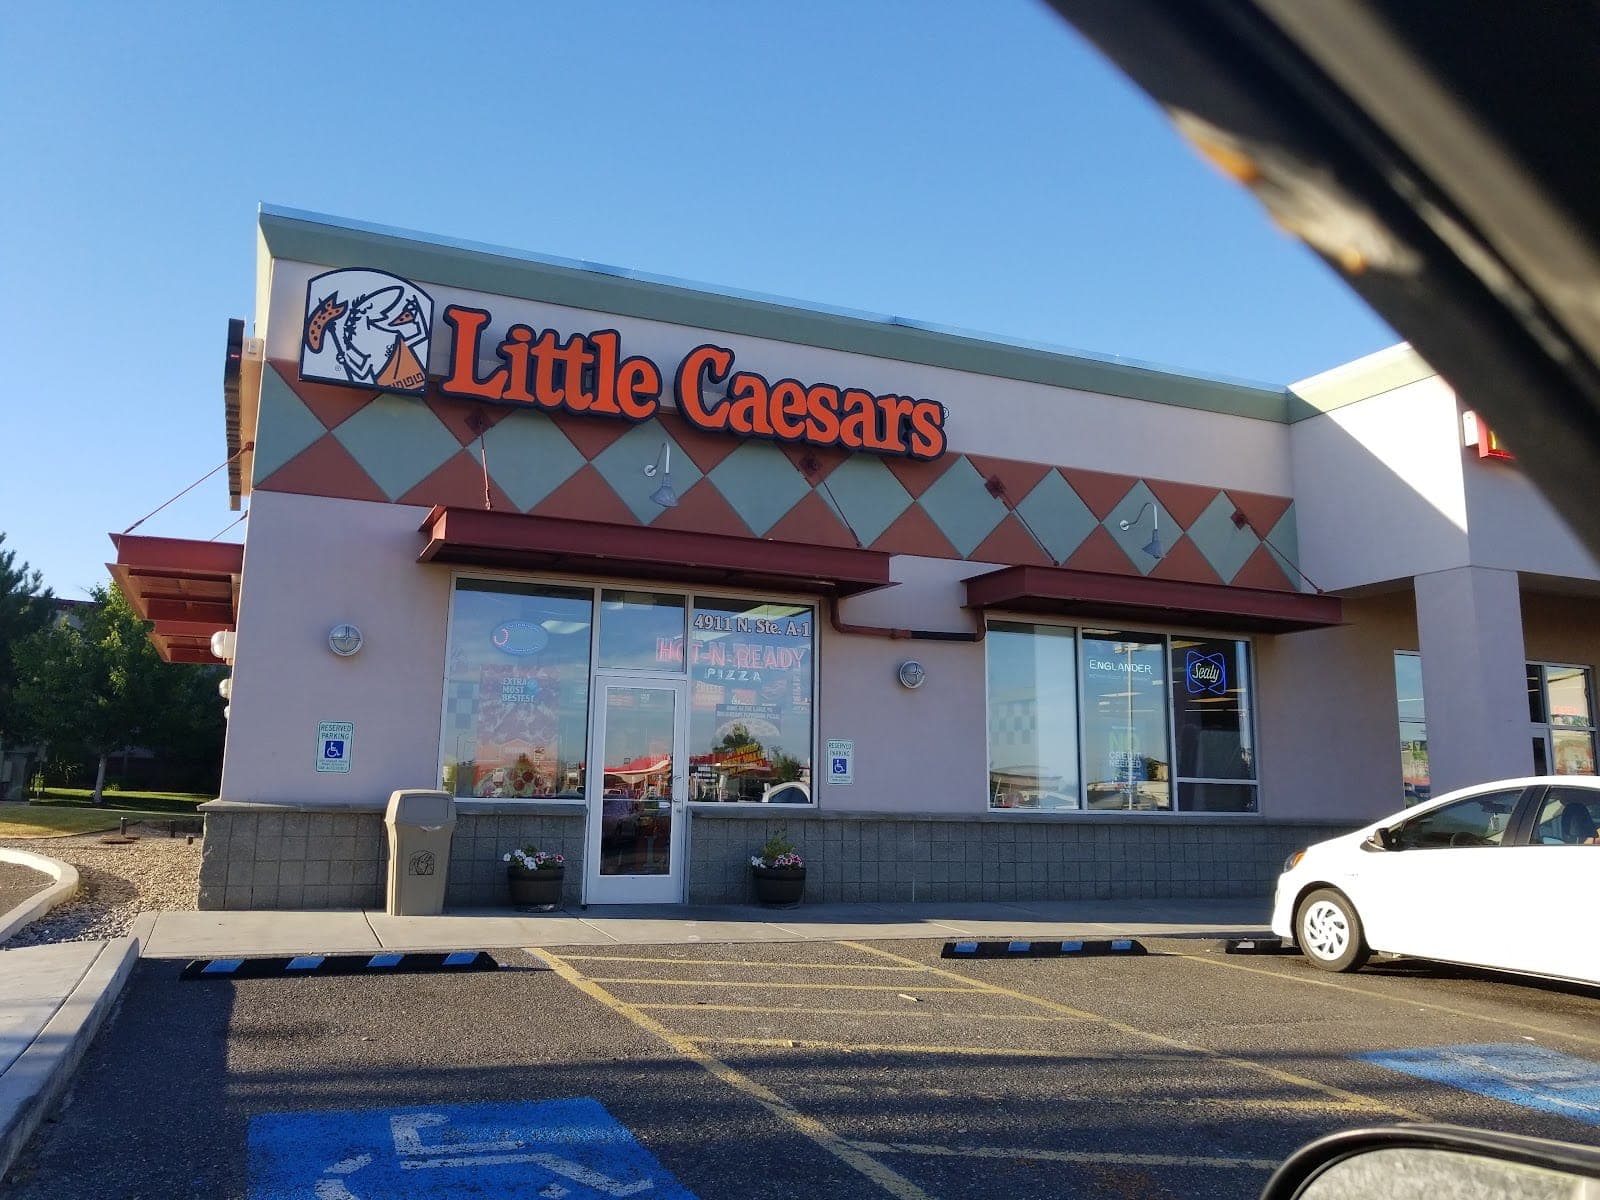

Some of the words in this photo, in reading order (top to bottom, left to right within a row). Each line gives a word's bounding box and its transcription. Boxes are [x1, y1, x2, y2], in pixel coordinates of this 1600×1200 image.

[443, 306, 661, 421] Little
[675, 345, 945, 460] Caesars
[694, 614, 732, 631] 4911
[736, 618, 752, 632] N.
[756, 619, 782, 634] Ste.
[786, 621, 812, 637] A-1
[1089, 659, 1153, 675] ENGLANDER
[1192, 662, 1220, 683] Sealy
[503, 677, 528, 686] EXTRA
[705, 668, 762, 681] PIZZA
[502, 686, 525, 694] MOST
[502, 694, 536, 702] BESTEST
